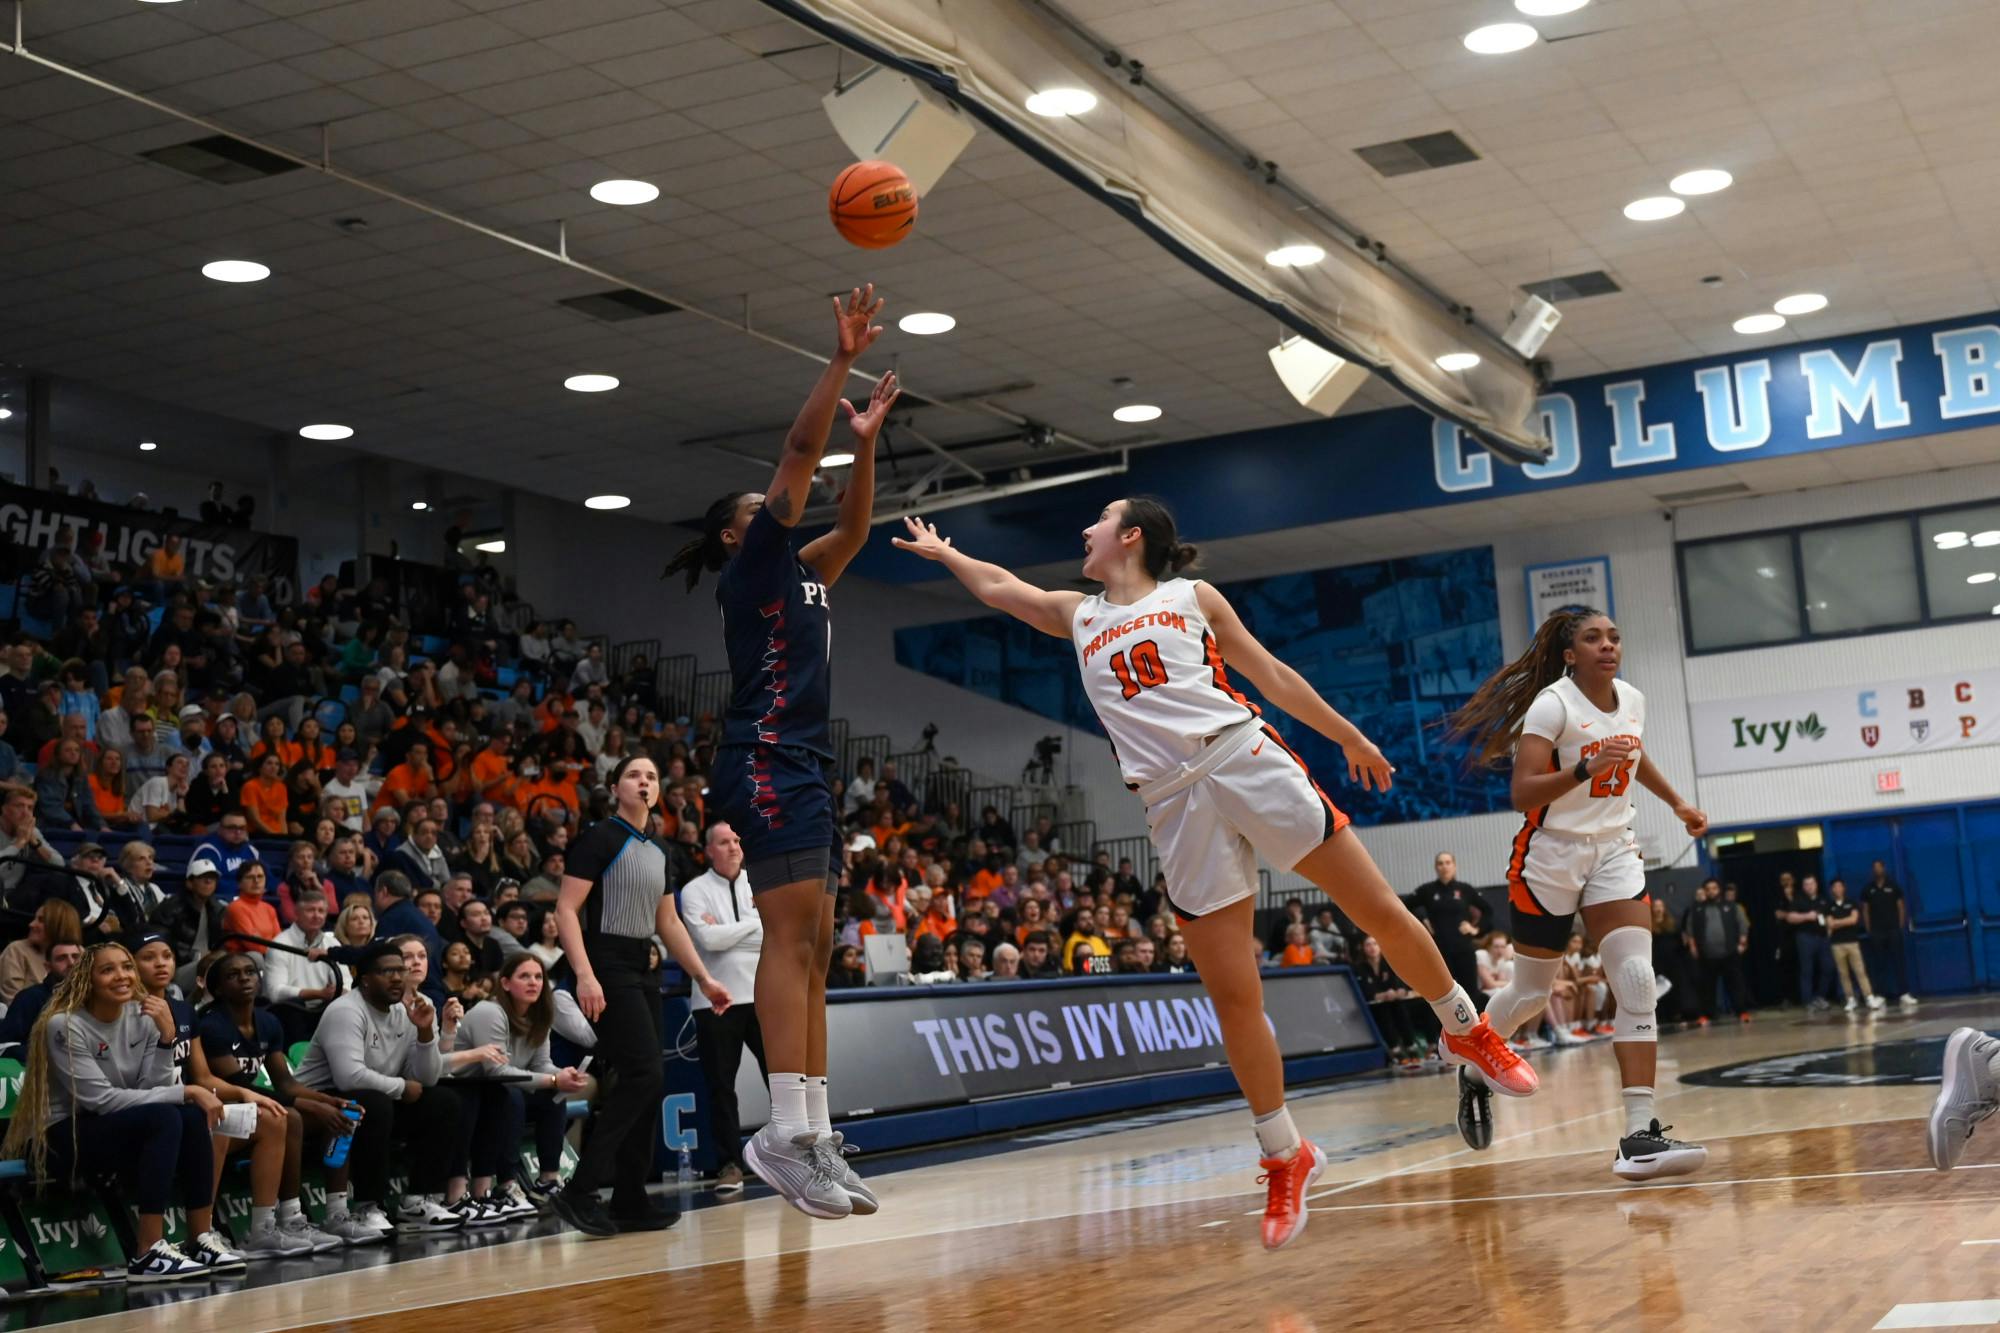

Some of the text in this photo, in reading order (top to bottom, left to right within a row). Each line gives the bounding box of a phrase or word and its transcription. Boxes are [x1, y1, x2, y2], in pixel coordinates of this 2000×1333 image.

[1083, 611, 1187, 667] PRINCETON
[1110, 639, 1169, 701] 10
[1907, 688, 1926, 709] B
[1954, 682, 1973, 703] C
[1731, 717, 1791, 752] Ivy
[1958, 716, 1977, 738] P
[913, 1012, 1020, 1076] THIS
[1013, 1009, 1063, 1065] IS
[1061, 1001, 1126, 1061] IVY
[662, 1092, 698, 1151] C
[31, 1217, 80, 1249] Ivy
